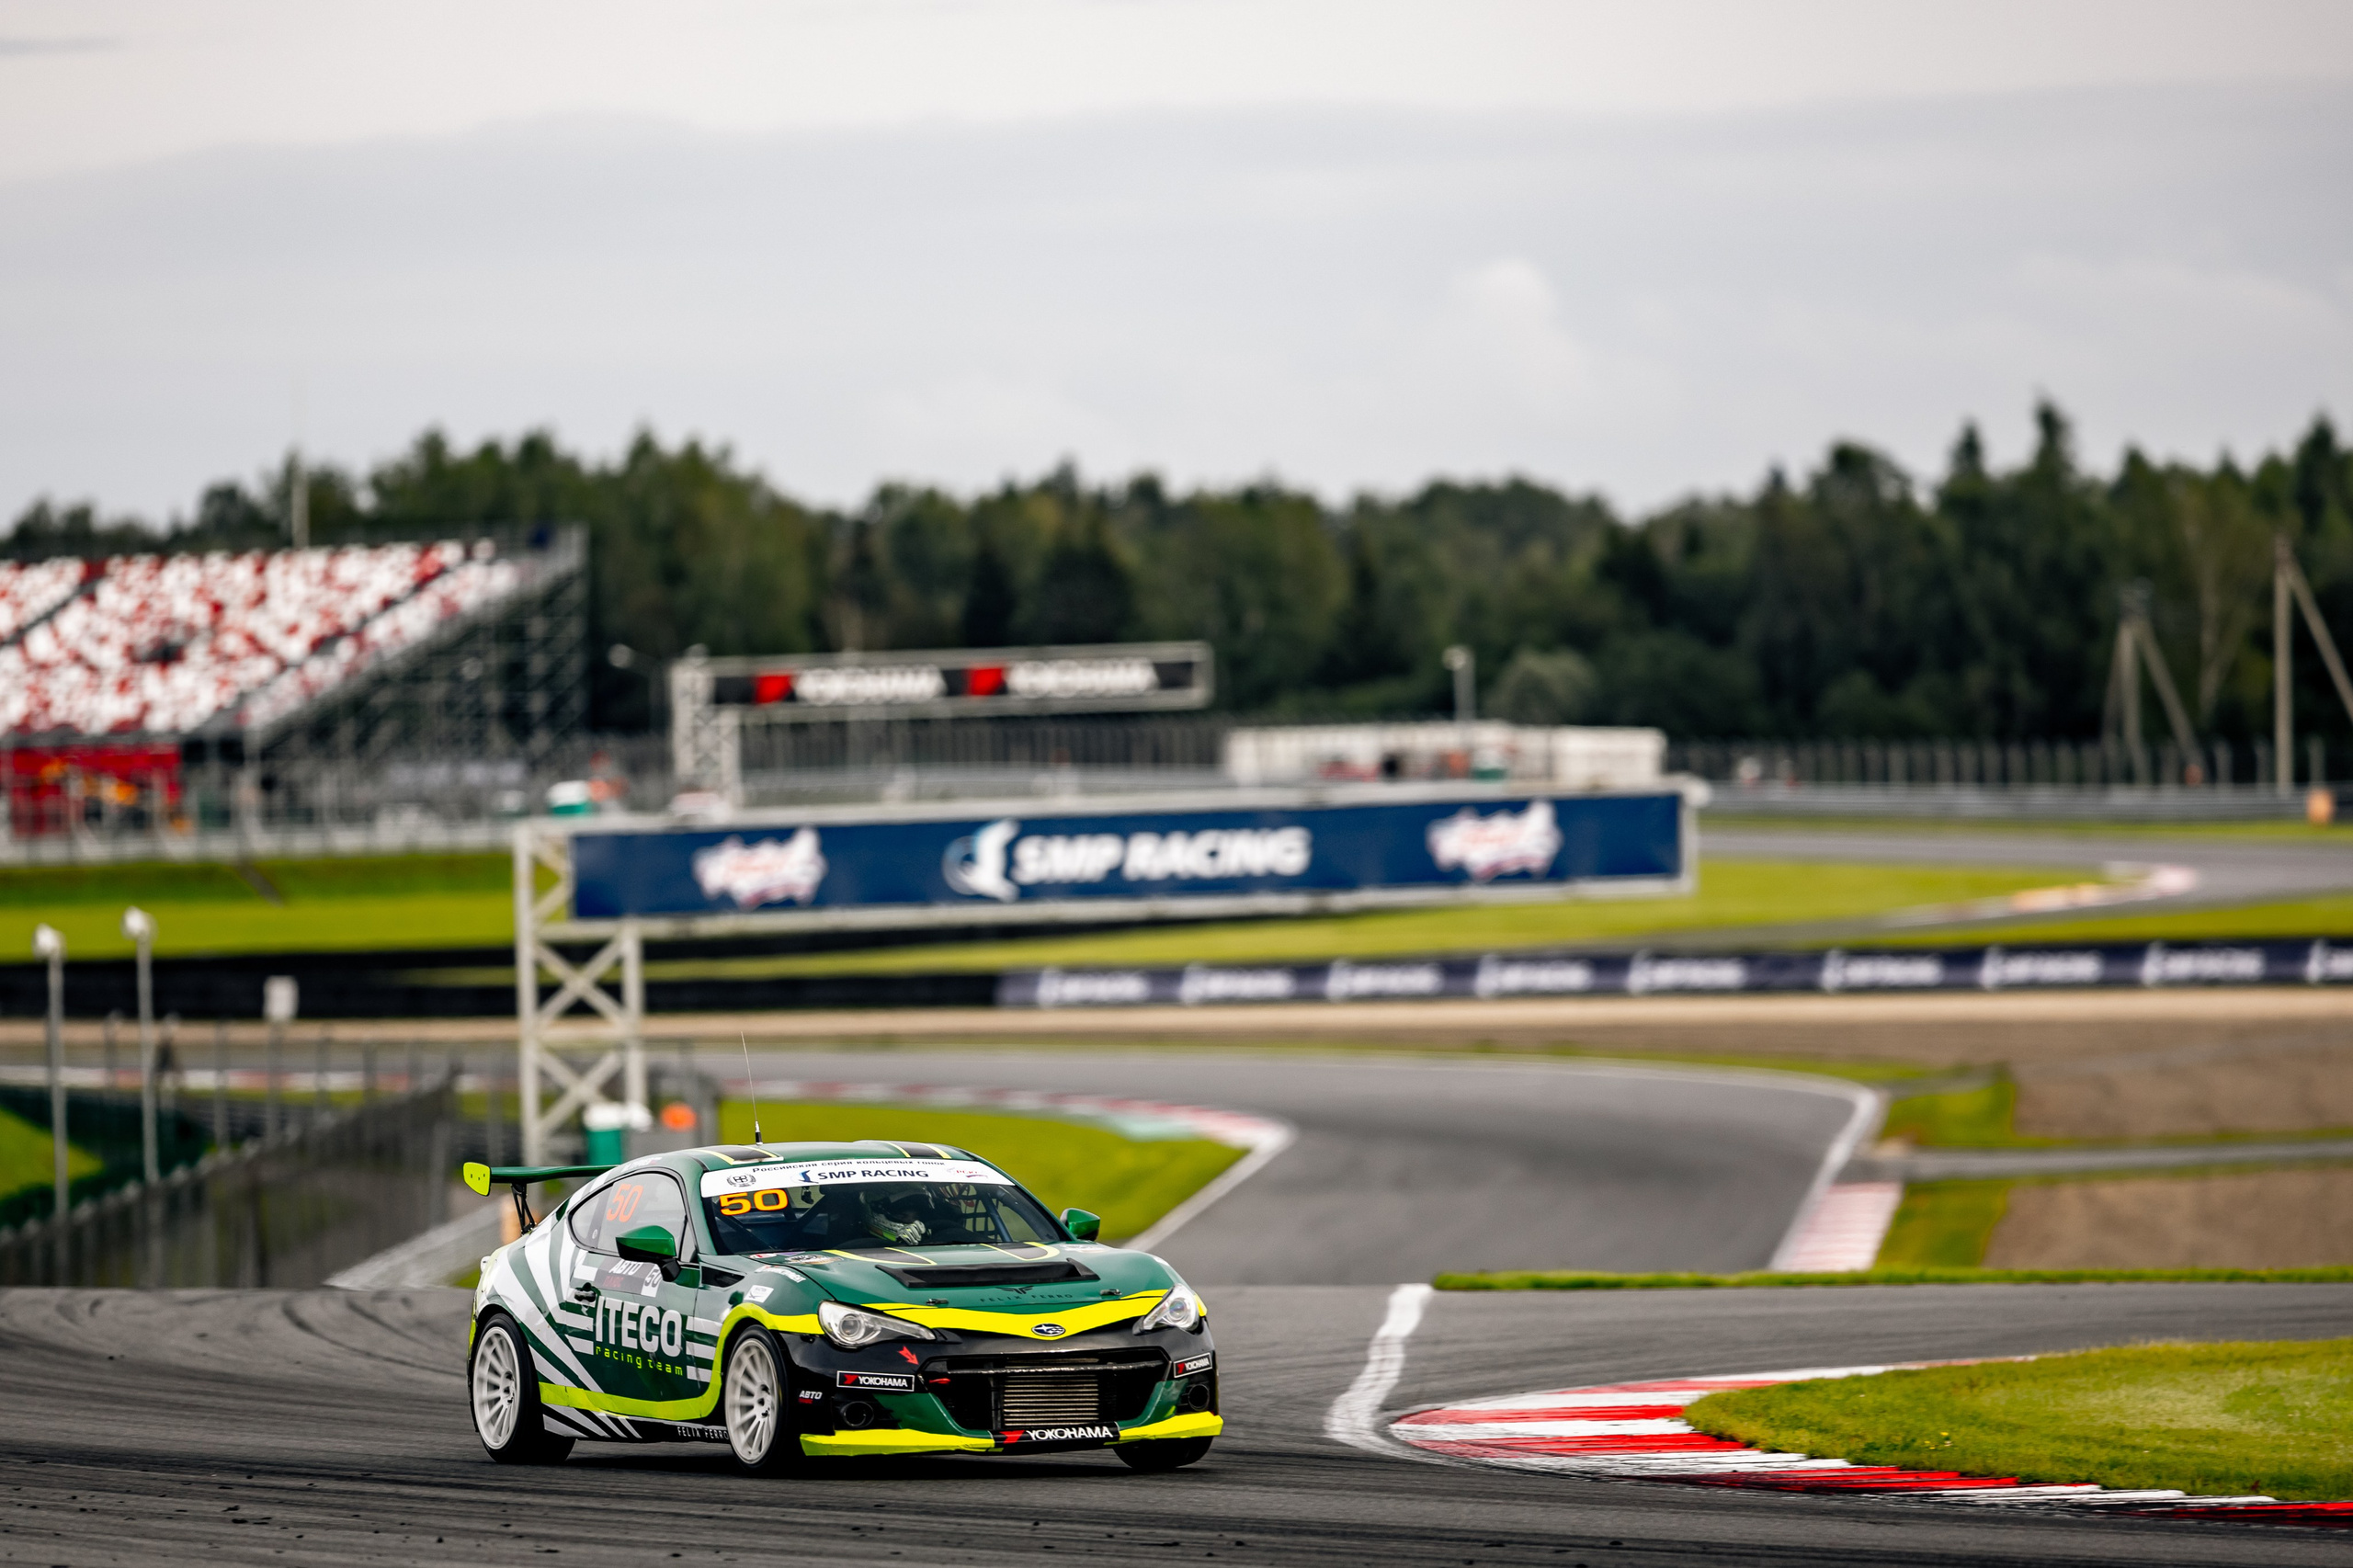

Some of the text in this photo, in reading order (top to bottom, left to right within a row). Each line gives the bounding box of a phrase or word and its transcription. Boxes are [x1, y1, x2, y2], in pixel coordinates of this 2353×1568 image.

[1013, 827, 1311, 884] SMP RACING
[817, 1169, 930, 1180] SMP RACING
[608, 1183, 643, 1223] 50
[719, 1187, 789, 1216] 50
[643, 1268, 662, 1288] 50
[596, 1295, 683, 1358] ITECO
[596, 1346, 683, 1376] racing team
[858, 1375, 908, 1388] YOKOHAMA
[676, 1426, 701, 1437] FELIX
[1026, 1426, 1114, 1441] YOKOHAMA
